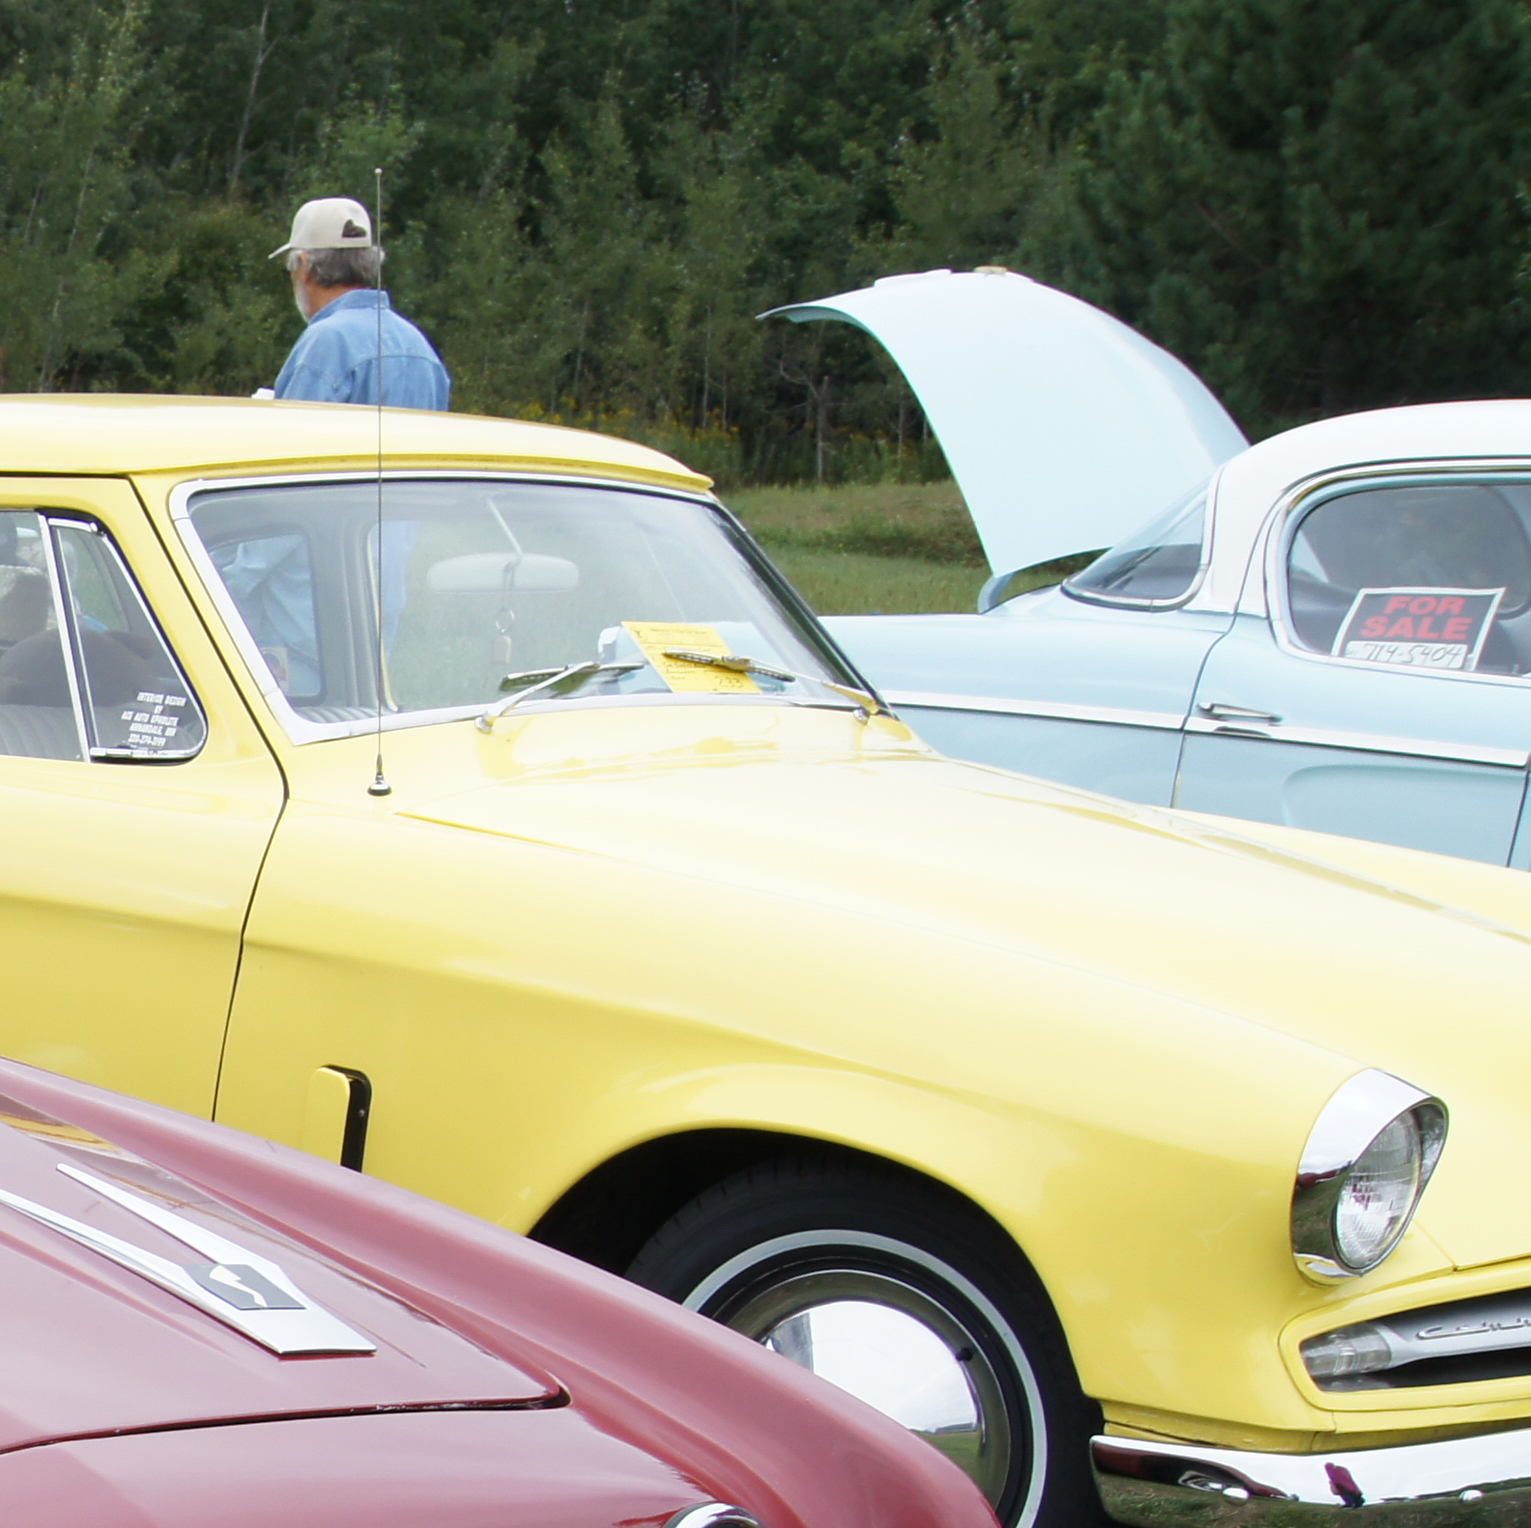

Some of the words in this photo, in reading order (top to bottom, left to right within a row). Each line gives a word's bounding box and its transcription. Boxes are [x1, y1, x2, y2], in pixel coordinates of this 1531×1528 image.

[1383, 596, 1466, 615] FOR
[1360, 616, 1473, 640] SALE
[137, 692, 164, 703] INTERIOR
[164, 695, 186, 706] DESIGN
[154, 705, 164, 714] BY
[134, 712, 150, 723] AUTO
